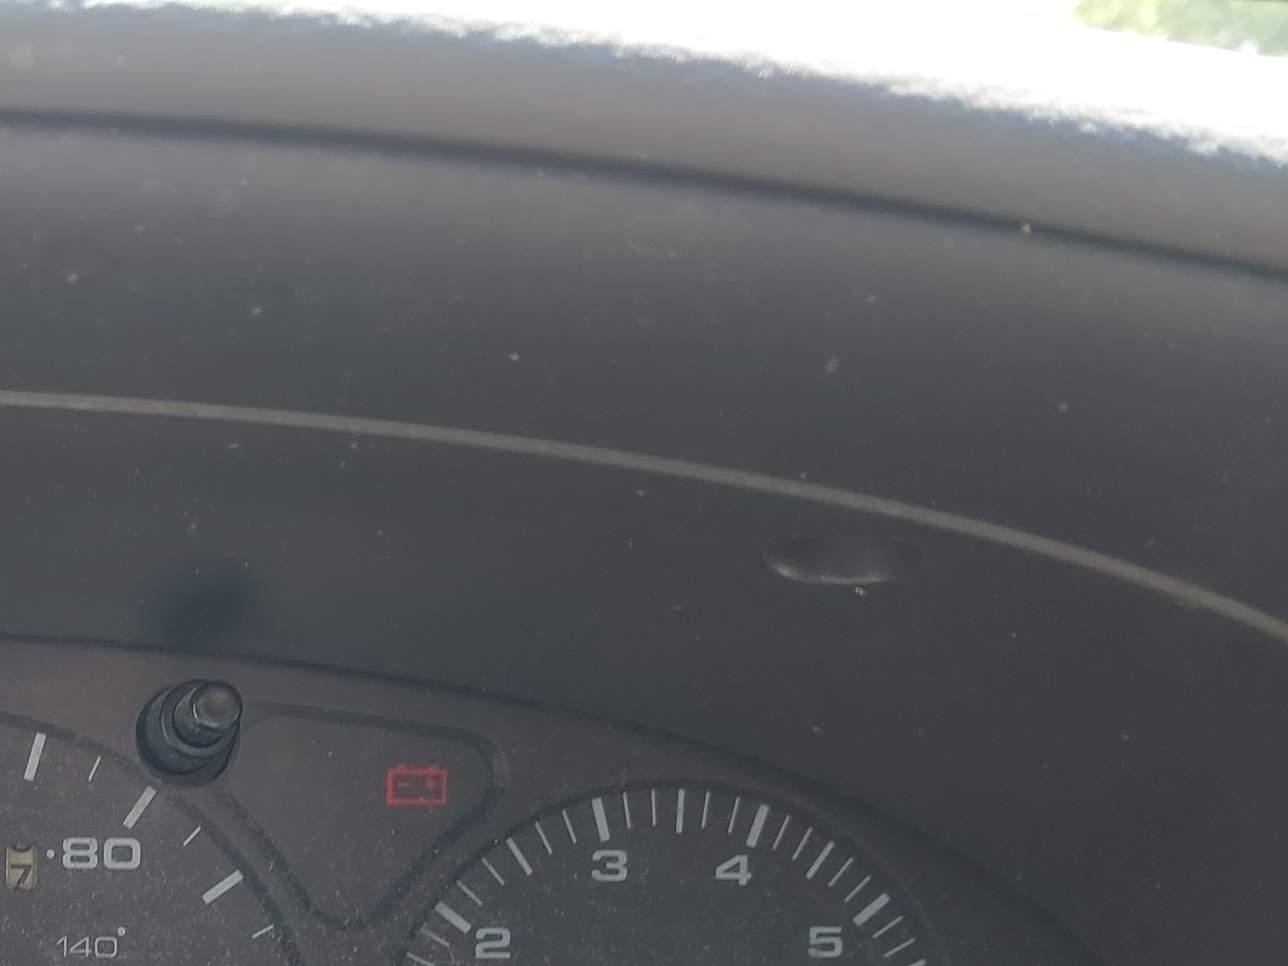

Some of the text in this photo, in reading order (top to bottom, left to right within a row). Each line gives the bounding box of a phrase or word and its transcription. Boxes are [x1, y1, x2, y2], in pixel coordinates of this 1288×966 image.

[62, 837, 141, 870] 80
[591, 849, 628, 882] 3
[715, 854, 752, 886] 4
[56, 935, 118, 958] 140
[475, 927, 511, 959] 2
[808, 926, 843, 958] 5
